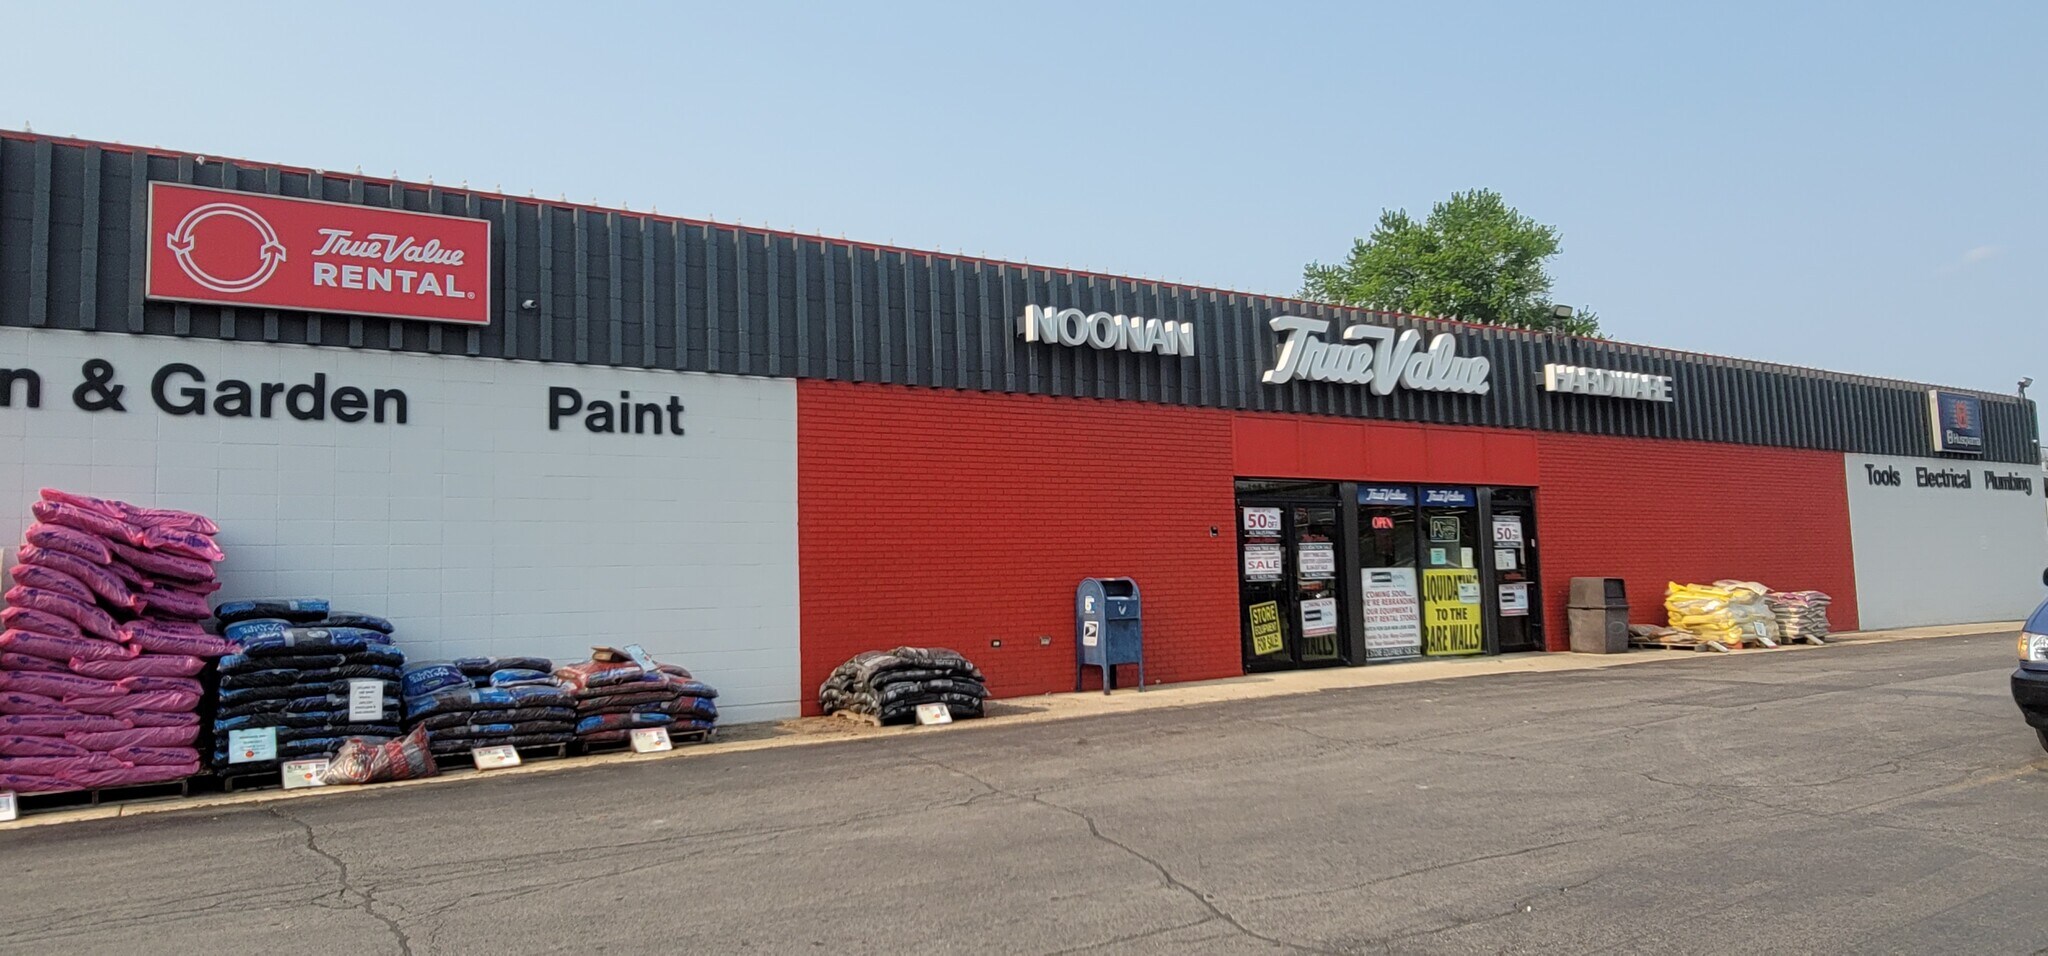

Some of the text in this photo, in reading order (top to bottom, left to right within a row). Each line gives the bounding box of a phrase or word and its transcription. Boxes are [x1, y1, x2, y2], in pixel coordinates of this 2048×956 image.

[313, 262, 465, 298] RENTAL
[1025, 304, 1194, 357] NOONAN
[72, 358, 126, 412] &
[151, 363, 407, 425] Garden
[1545, 363, 1673, 402] HARDWARE
[549, 386, 685, 436] Paint
[1864, 463, 1901, 487] Tools
[1915, 466, 1971, 489] Electrical
[1984, 470, 2032, 496] Plumbing
[1248, 513, 1267, 529] 50
[1372, 516, 1394, 529] OPEN
[1496, 527, 1512, 540] 50
[1248, 560, 1280, 570] SALE
[1252, 605, 1276, 625] STORE
[1435, 607, 1468, 621] TO THE
[1449, 624, 1479, 650] WALLS
